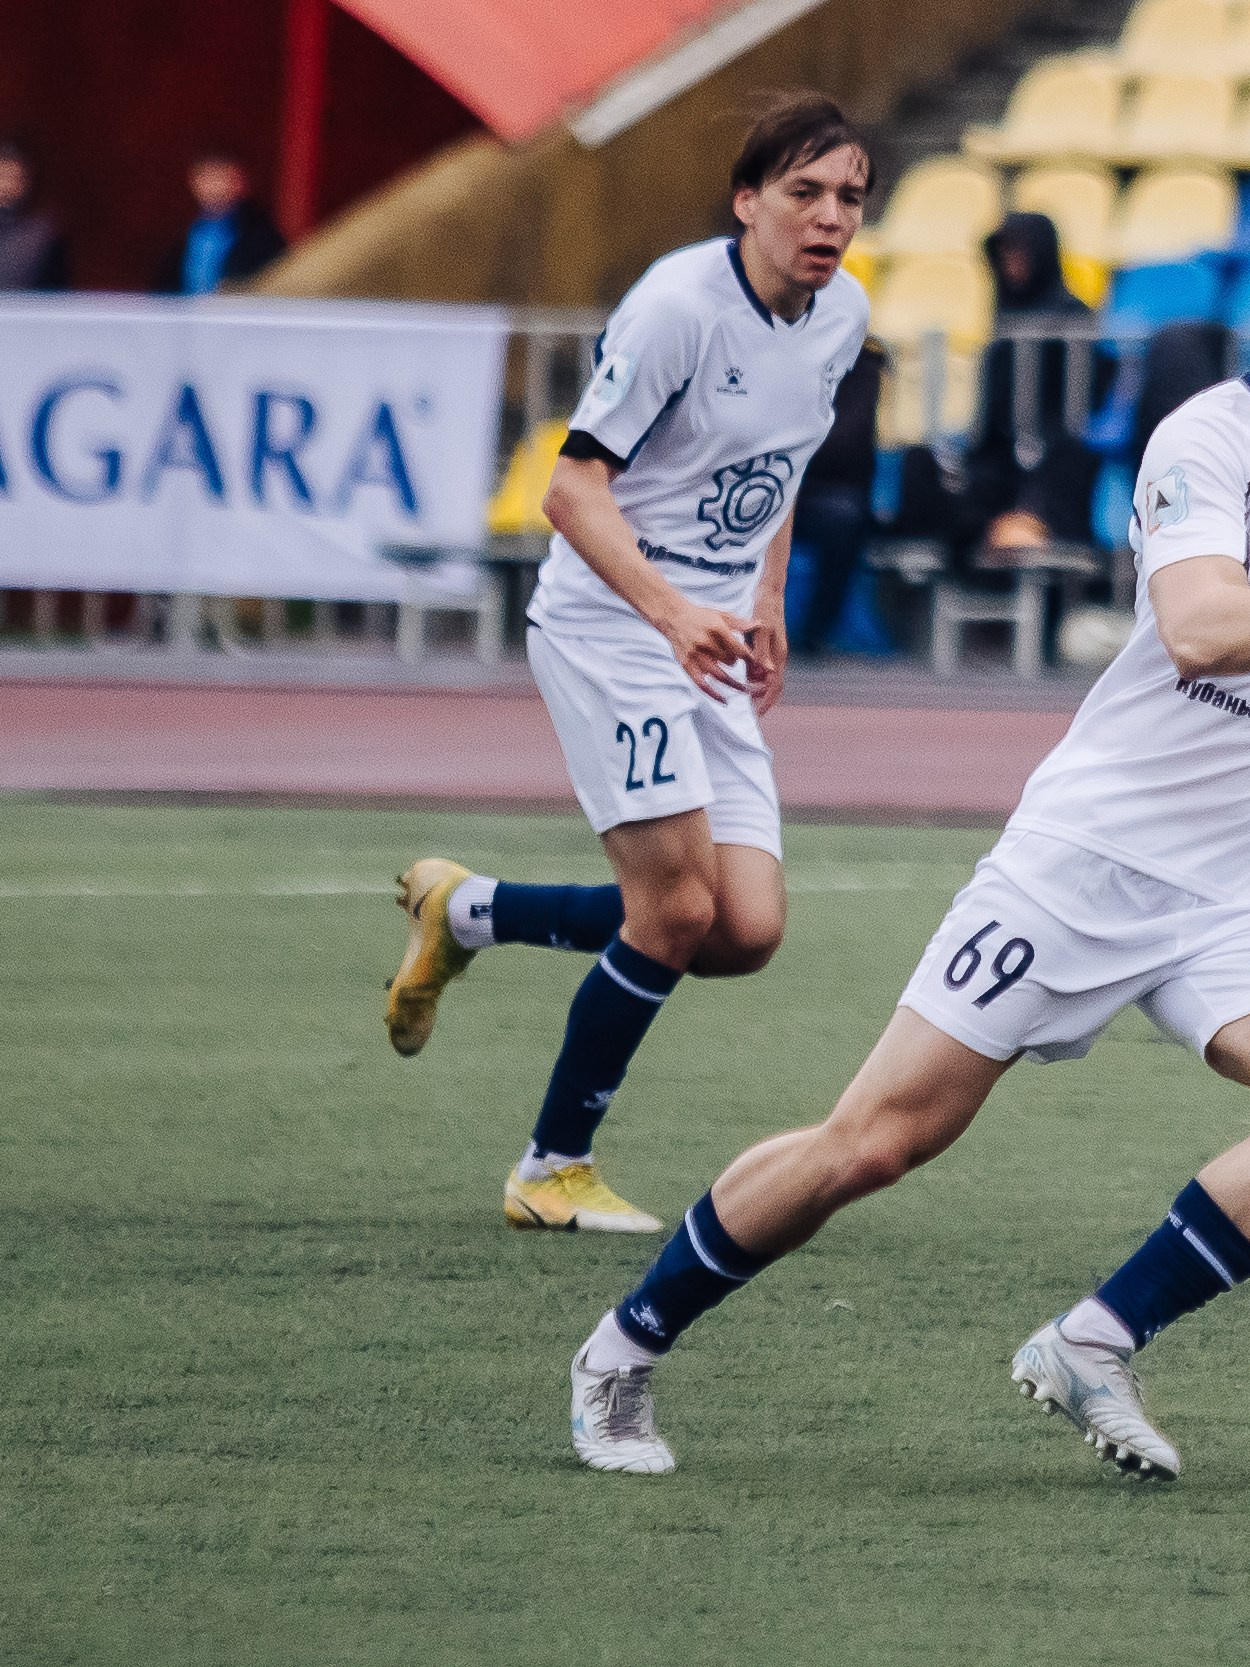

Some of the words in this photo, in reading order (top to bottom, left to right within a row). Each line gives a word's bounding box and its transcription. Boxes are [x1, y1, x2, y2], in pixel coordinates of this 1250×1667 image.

[0, 368, 420, 518] GARA
[616, 717, 676, 791] 22
[943, 919, 1035, 1011] 69
